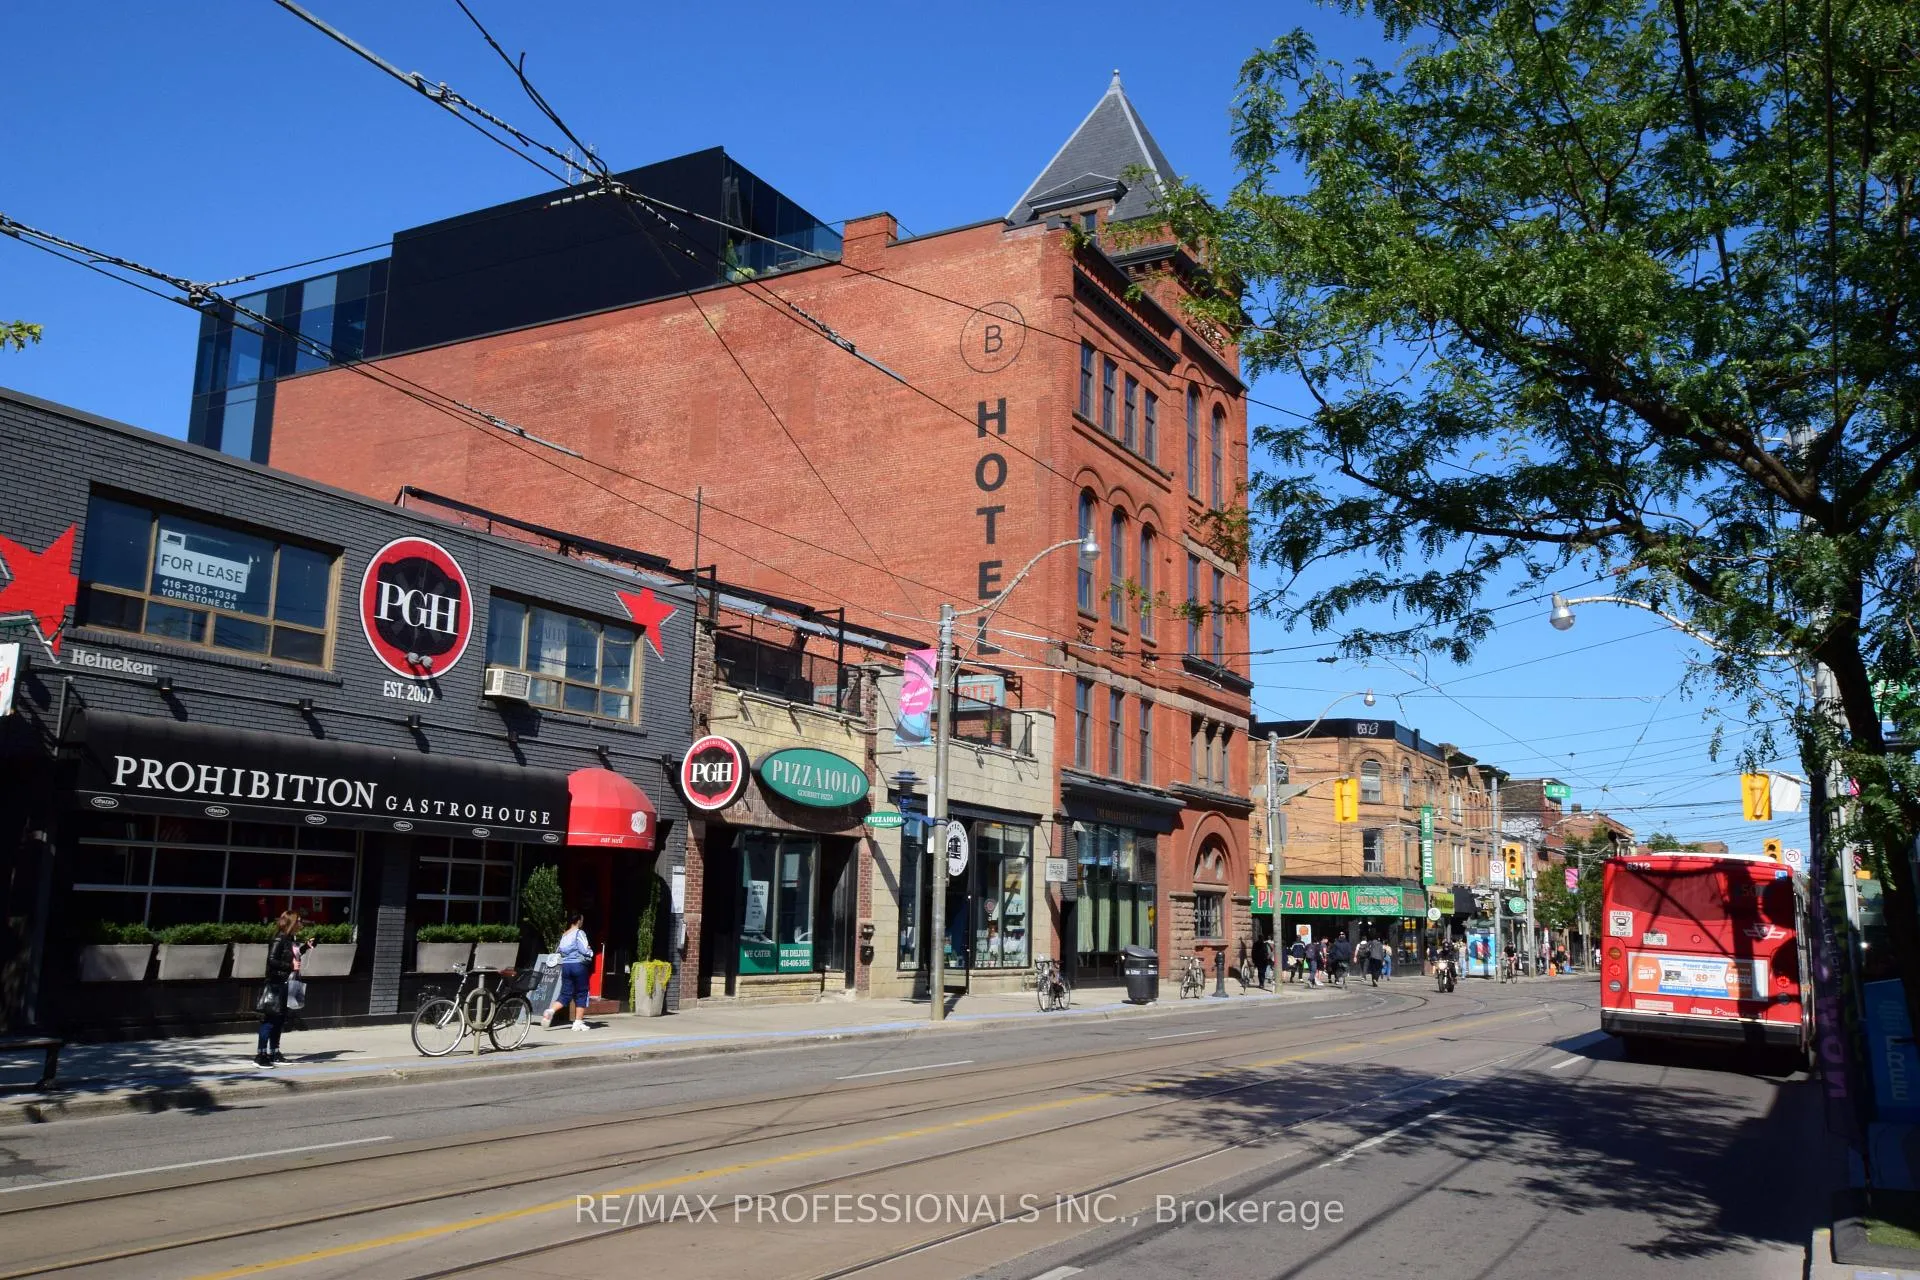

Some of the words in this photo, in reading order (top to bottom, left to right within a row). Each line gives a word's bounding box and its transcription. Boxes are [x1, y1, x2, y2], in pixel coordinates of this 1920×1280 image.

[985, 325, 1003, 353] B
[975, 397, 1008, 656] HOTEL
[161, 554, 193, 573] FOR
[197, 562, 244, 583] LEASE
[161, 588, 236, 610] YORKSTONE.CA
[162, 579, 237, 601] 416-203-1334
[374, 580, 461, 635] PGH
[71, 650, 154, 676] Heineken
[384, 680, 404, 699] EST.
[407, 685, 433, 703] 2007
[689, 762, 735, 783] PGH
[772, 759, 861, 795] PIZZAIOLO
[111, 755, 378, 809] PROHIBITION
[385, 796, 551, 825] GASTROHOUSE
[1309, 890, 1350, 910] NOVA
